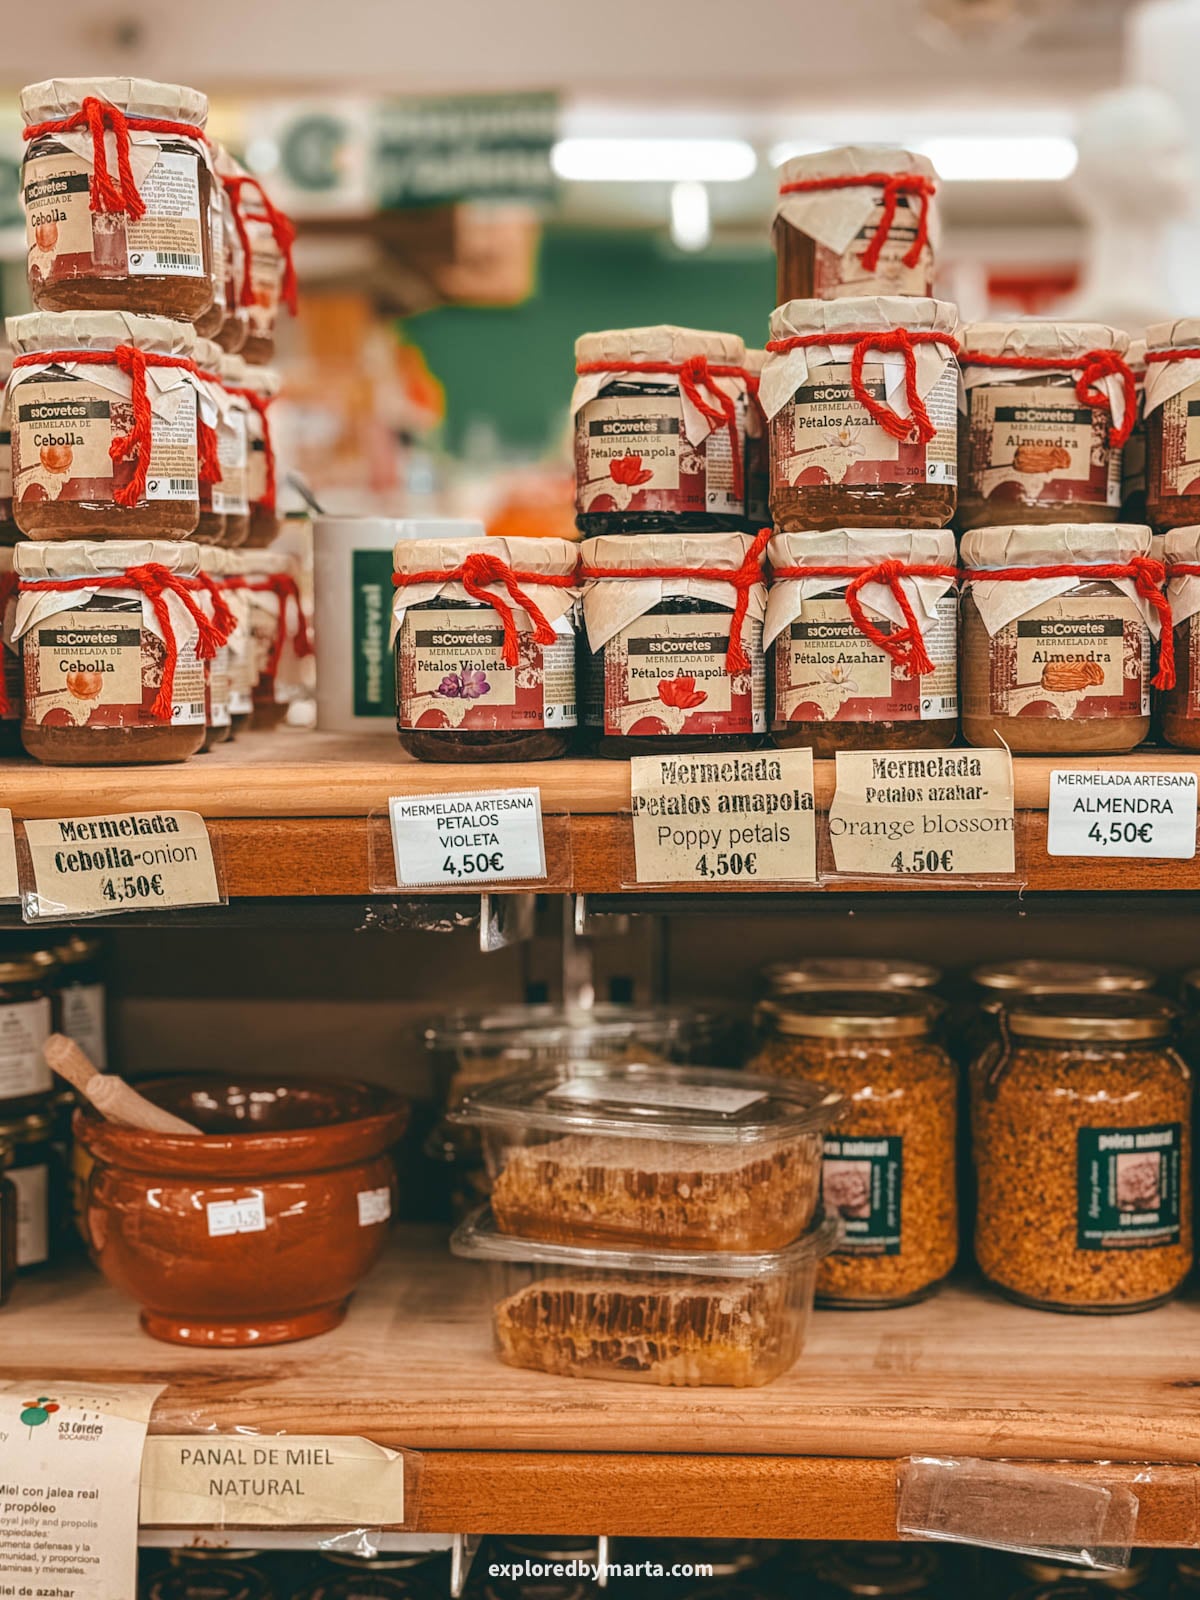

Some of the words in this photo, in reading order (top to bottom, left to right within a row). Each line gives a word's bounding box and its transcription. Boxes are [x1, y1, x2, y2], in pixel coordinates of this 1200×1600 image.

[32, 208, 67, 227] Cebolla
[814, 387, 876, 400] 53Coves
[31, 405, 86, 418] 53Covetes
[29, 420, 77, 430] MERMELADA
[80, 420, 91, 428] DE
[799, 417, 842, 428] Pétalos
[844, 416, 878, 426] Azah
[1010, 424, 1065, 432] MERMELADA
[1067, 424, 1076, 432] DE
[34, 432, 84, 446] Cebolla
[600, 436, 648, 444] MERMELADA
[1006, 434, 1078, 448] Almendra
[591, 448, 622, 458] Pétalos
[625, 446, 676, 460] Amapola
[808, 625, 866, 638] 53Covete
[1041, 623, 1104, 636] 53Covetes
[56, 633, 118, 645] 53Covetes
[432, 632, 492, 646] 53Covetes
[804, 640, 858, 648] MERMELADA
[860, 640, 872, 648] DE
[1036, 638, 1097, 646] MERMELADA
[1100, 638, 1108, 646] DE
[54, 647, 108, 656] MERMELADA
[110, 647, 122, 656] DE
[429, 648, 482, 656] MERMELADA
[485, 648, 496, 656] DE
[650, 640, 712, 653] 53Covetes
[645, 656, 702, 664] MERMELADA
[704, 655, 715, 663] DE
[794, 652, 835, 664] Pétalos
[836, 652, 886, 664] Azahar
[1032, 651, 1112, 663] Almendra
[59, 660, 115, 673] Cebolla
[418, 660, 457, 672] Pétalos
[631, 666, 674, 678] Pétalos
[676, 666, 728, 680] Amapola
[900, 704, 912, 712] 210
[661, 758, 782, 784] Mermelada
[872, 756, 982, 780] Mermelada
[1057, 774, 1132, 786] MERMELADA
[1134, 775, 1196, 787] ARTESANA
[866, 786, 923, 804] Petalos
[401, 802, 473, 818] MERMELADA
[474, 798, 534, 812] ARTESANA
[632, 794, 710, 816] Petalos
[718, 790, 814, 814] amapola
[1072, 798, 1174, 814] ALMENDRA
[58, 815, 180, 842] Mermelada
[437, 814, 499, 830] PETALOS
[830, 816, 914, 840] Orange
[922, 814, 1014, 834] blossom
[440, 832, 500, 848] VIOLETA
[658, 825, 722, 850] Poppy
[730, 822, 790, 846] petals
[1088, 822, 1154, 846] 4,50€
[442, 852, 504, 878] 4,50€
[696, 852, 757, 878] 4,50€
[102, 874, 165, 902] 4,50€
[180, 1448, 247, 1465] PANAL
[253, 1448, 279, 1465] DE
[286, 1448, 334, 1465] MIEL
[22, 1488, 44, 1496] con
[46, 1486, 74, 1500] jalea
[77, 1489, 99, 1500] real
[209, 1479, 304, 1496] NATURAL
[4, 1502, 56, 1514] propóleo
[0, 1516, 19, 1527] oyal
[20, 1516, 40, 1527] jelly
[42, 1518, 59, 1526] and
[61, 1520, 98, 1529] propolis
[0, 1528, 50, 1538] ropiedades:
[0, 1540, 31, 1549] umenta
[33, 1541, 73, 1551] defensas
[75, 1544, 81, 1552] y
[82, 1543, 90, 1552] la
[0, 1552, 39, 1562] munidad,
[41, 1555, 48, 1563] y
[49, 1554, 100, 1564] proporciona
[0, 1563, 32, 1572] taminas
[34, 1566, 40, 1574] y
[18, 1586, 33, 1596] de
[36, 1588, 75, 1598] azahar
